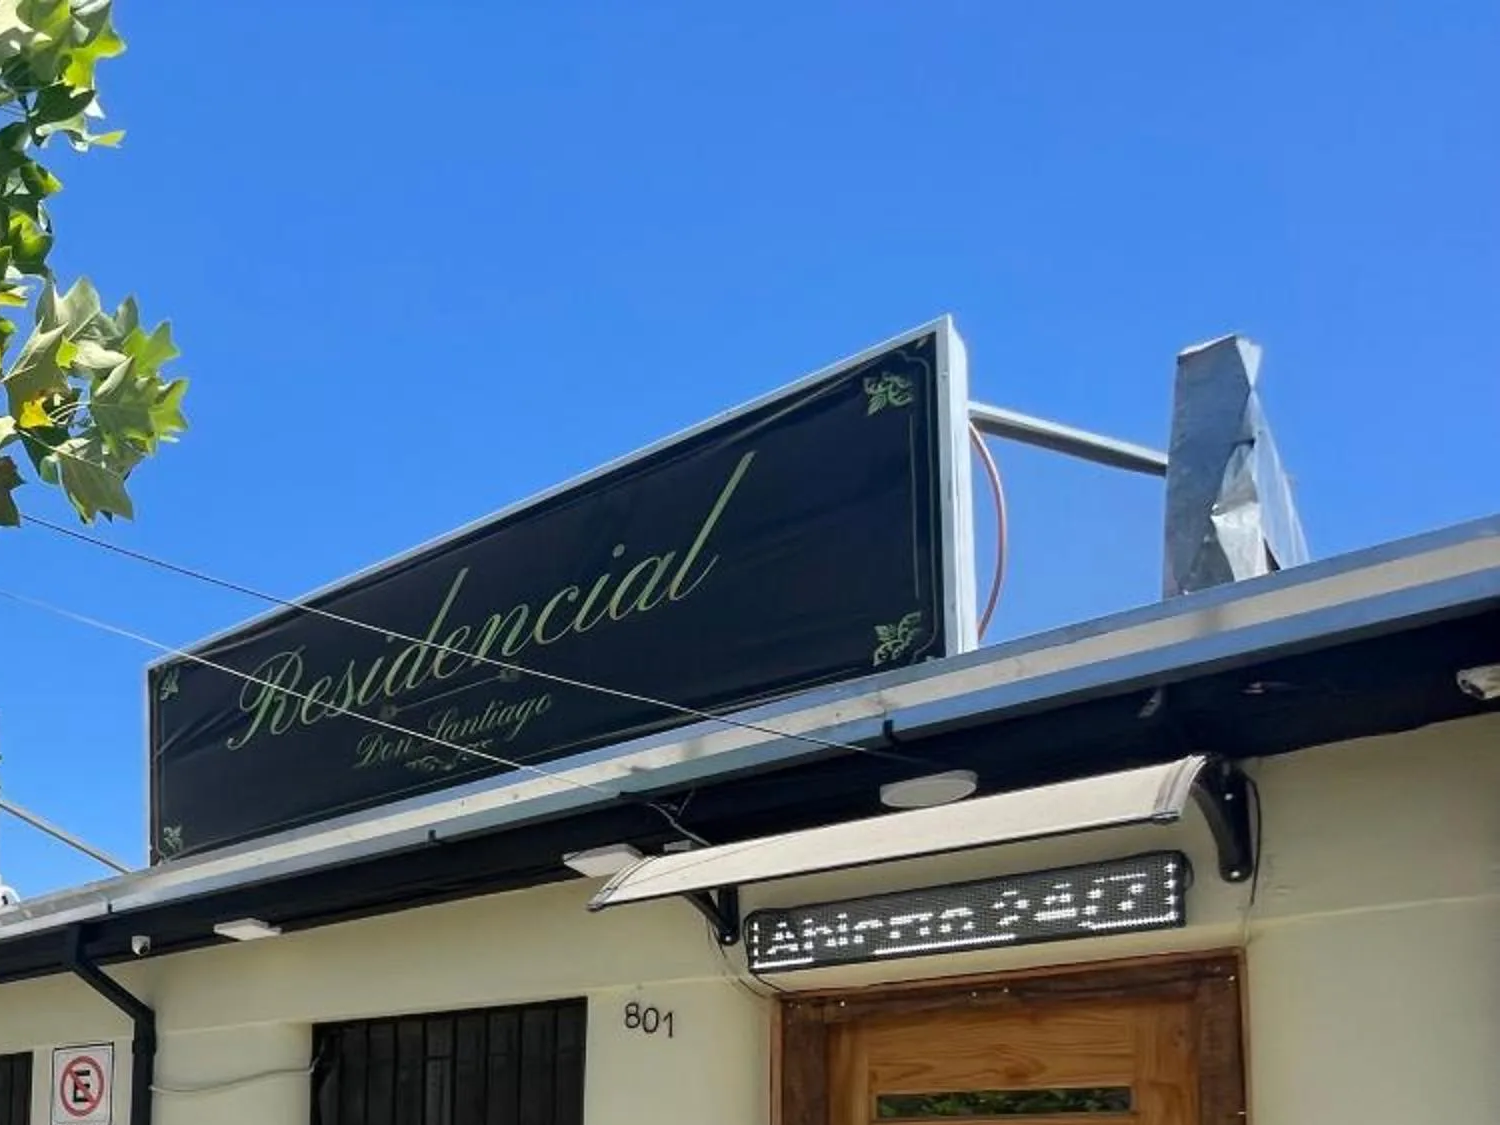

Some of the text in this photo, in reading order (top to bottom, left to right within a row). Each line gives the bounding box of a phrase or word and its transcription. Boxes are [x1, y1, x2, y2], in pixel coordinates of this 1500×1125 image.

[227, 450, 756, 751] Residencial
[353, 692, 552, 769] Don Santiago
[625, 1001, 673, 1039] 801
